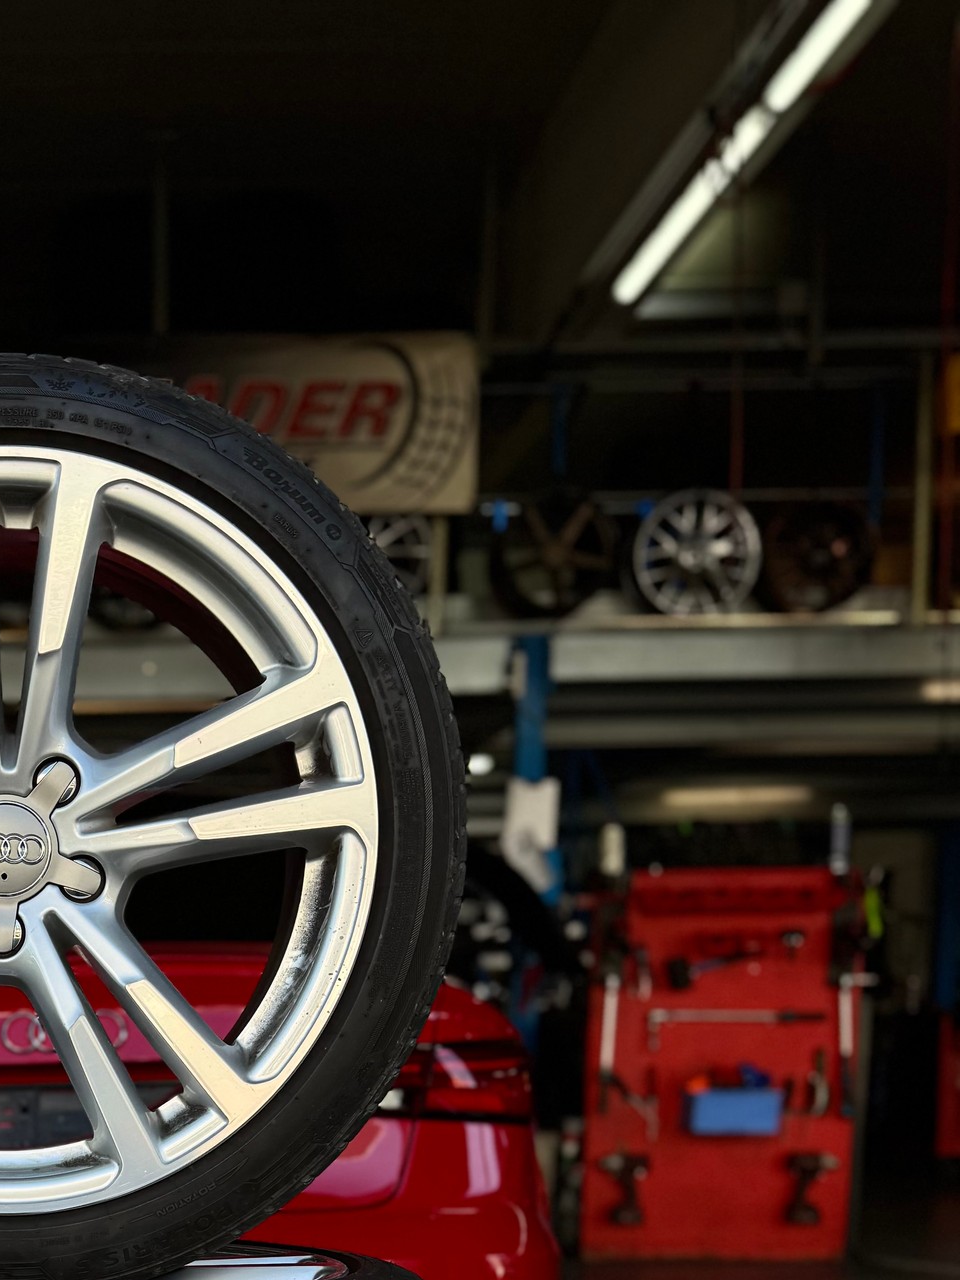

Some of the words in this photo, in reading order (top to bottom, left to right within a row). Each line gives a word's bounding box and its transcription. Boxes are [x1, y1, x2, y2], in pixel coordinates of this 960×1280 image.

[237, 445, 329, 527] Barum
[271, 511, 299, 539] BARUM
[154, 1180, 218, 1218] ROTATION
[99, 1201, 234, 1269] POLARIS
